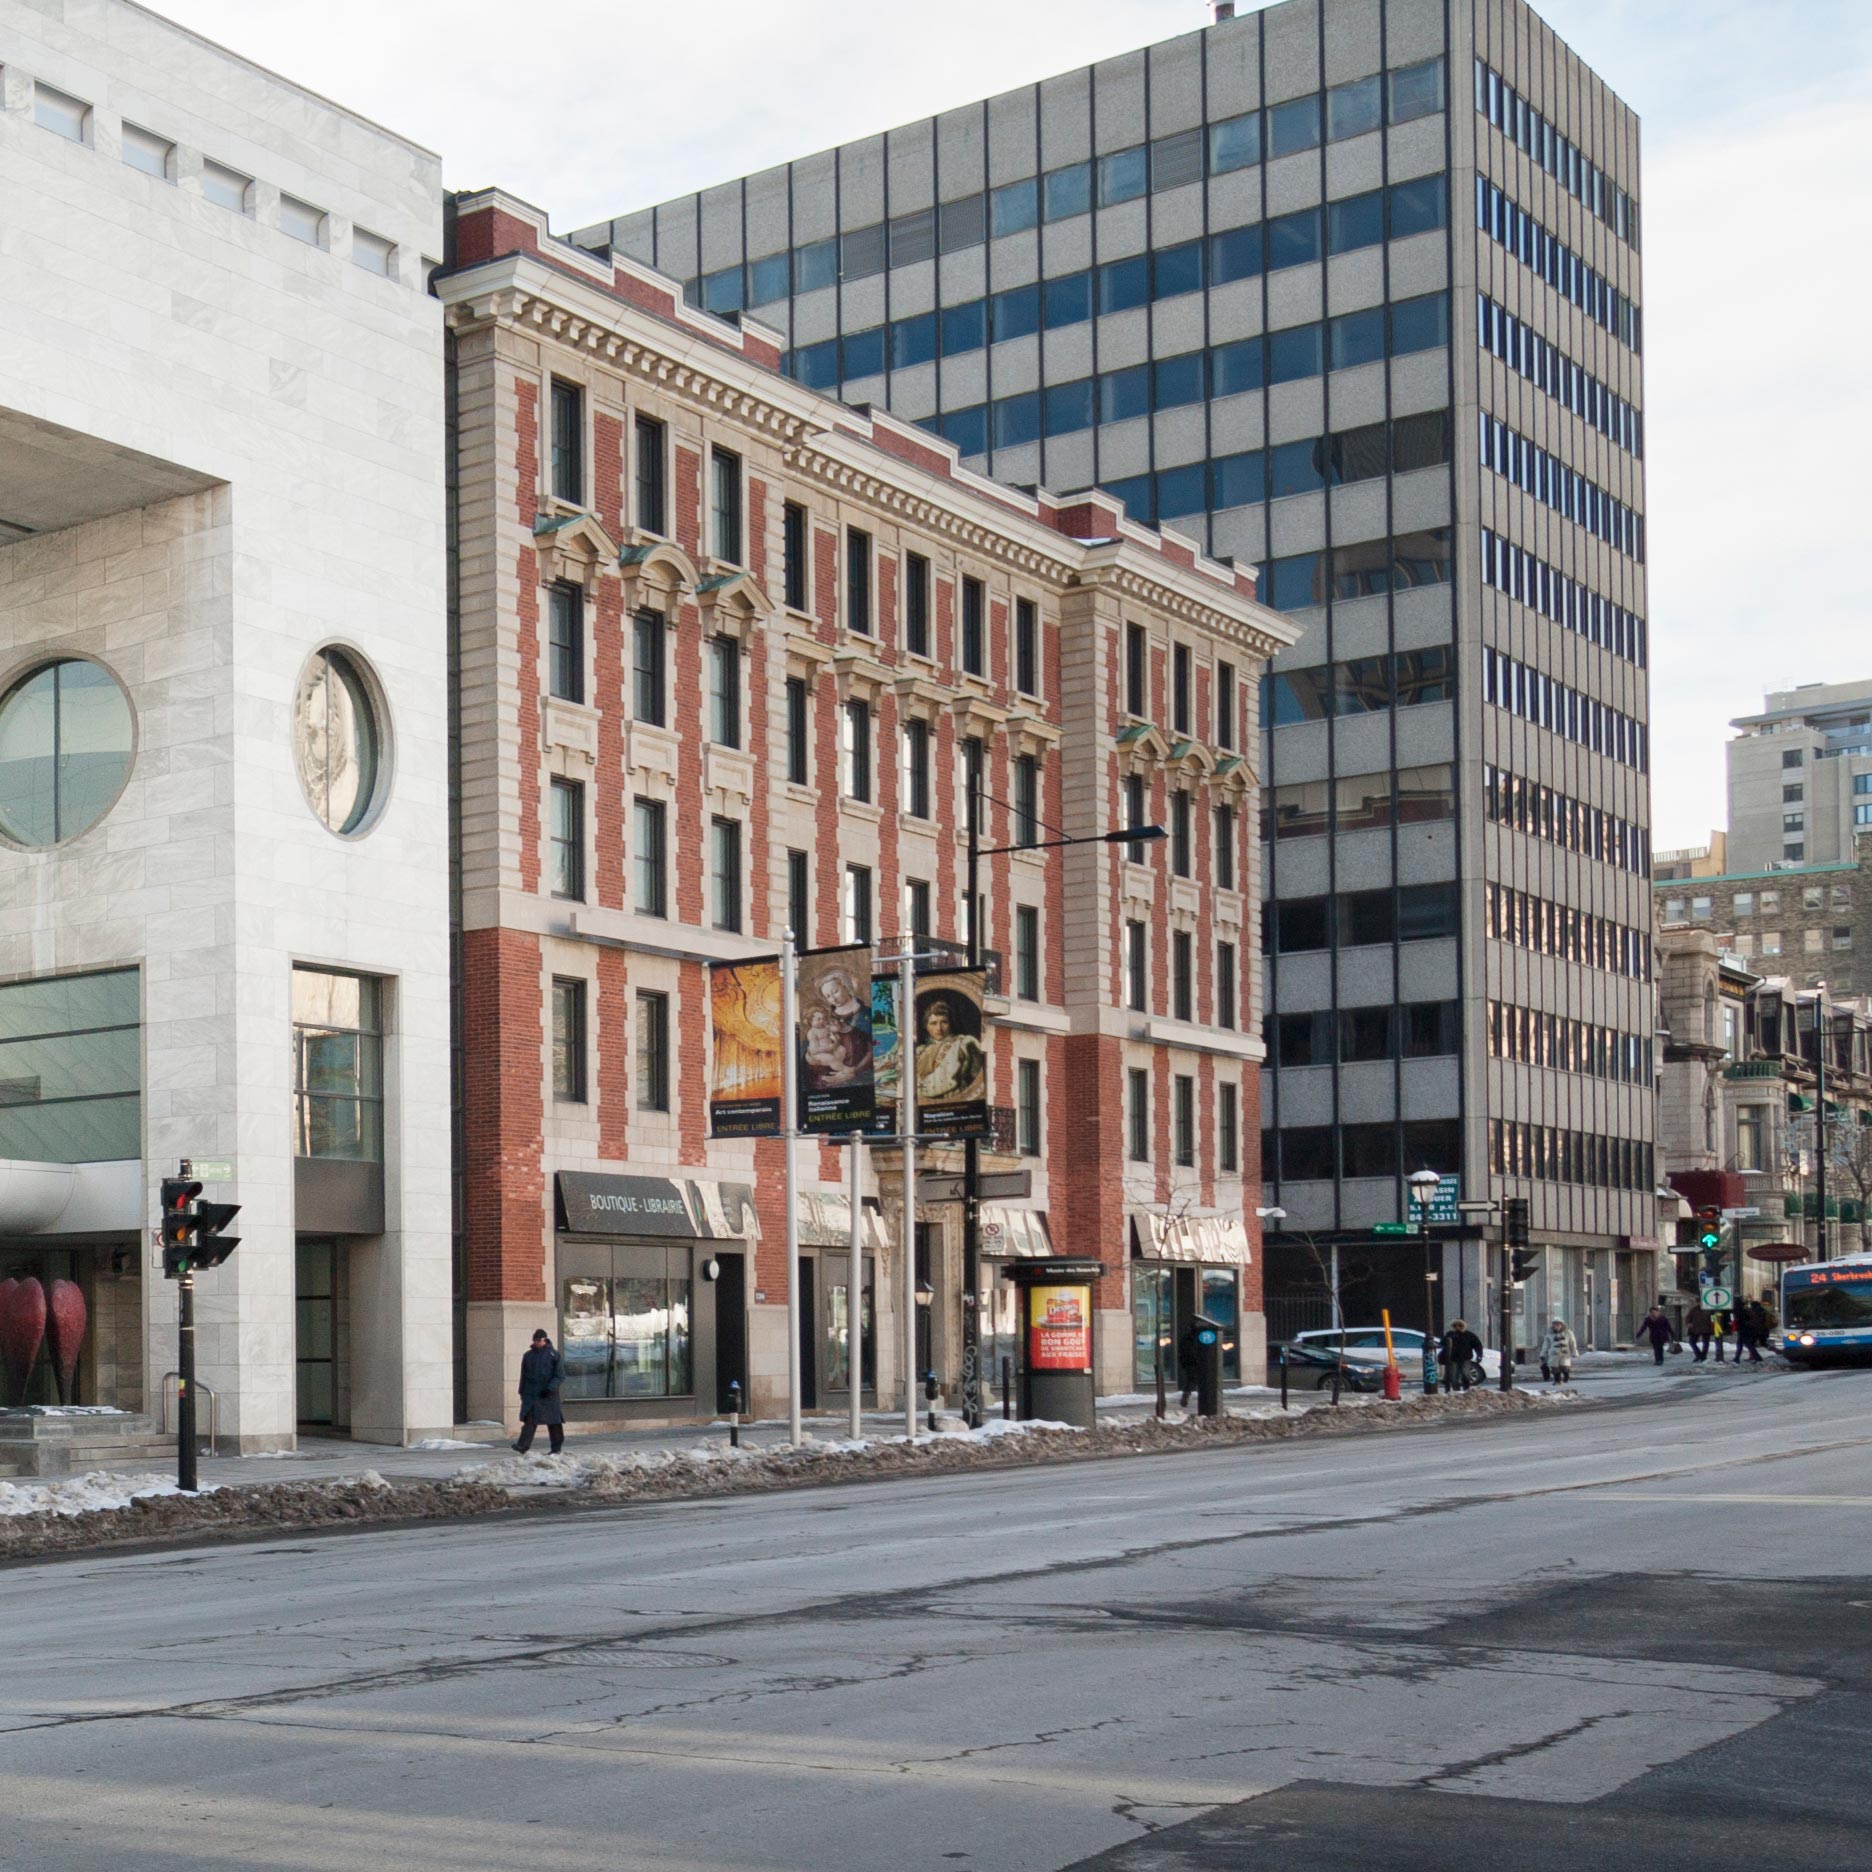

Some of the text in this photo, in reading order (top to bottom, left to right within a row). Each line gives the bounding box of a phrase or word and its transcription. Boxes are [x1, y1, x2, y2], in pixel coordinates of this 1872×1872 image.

[590, 1194, 638, 1213] BOUTIQUE
[643, 1198, 685, 1215] LIBRAIRIE
[1810, 1272, 1827, 1284] 24
